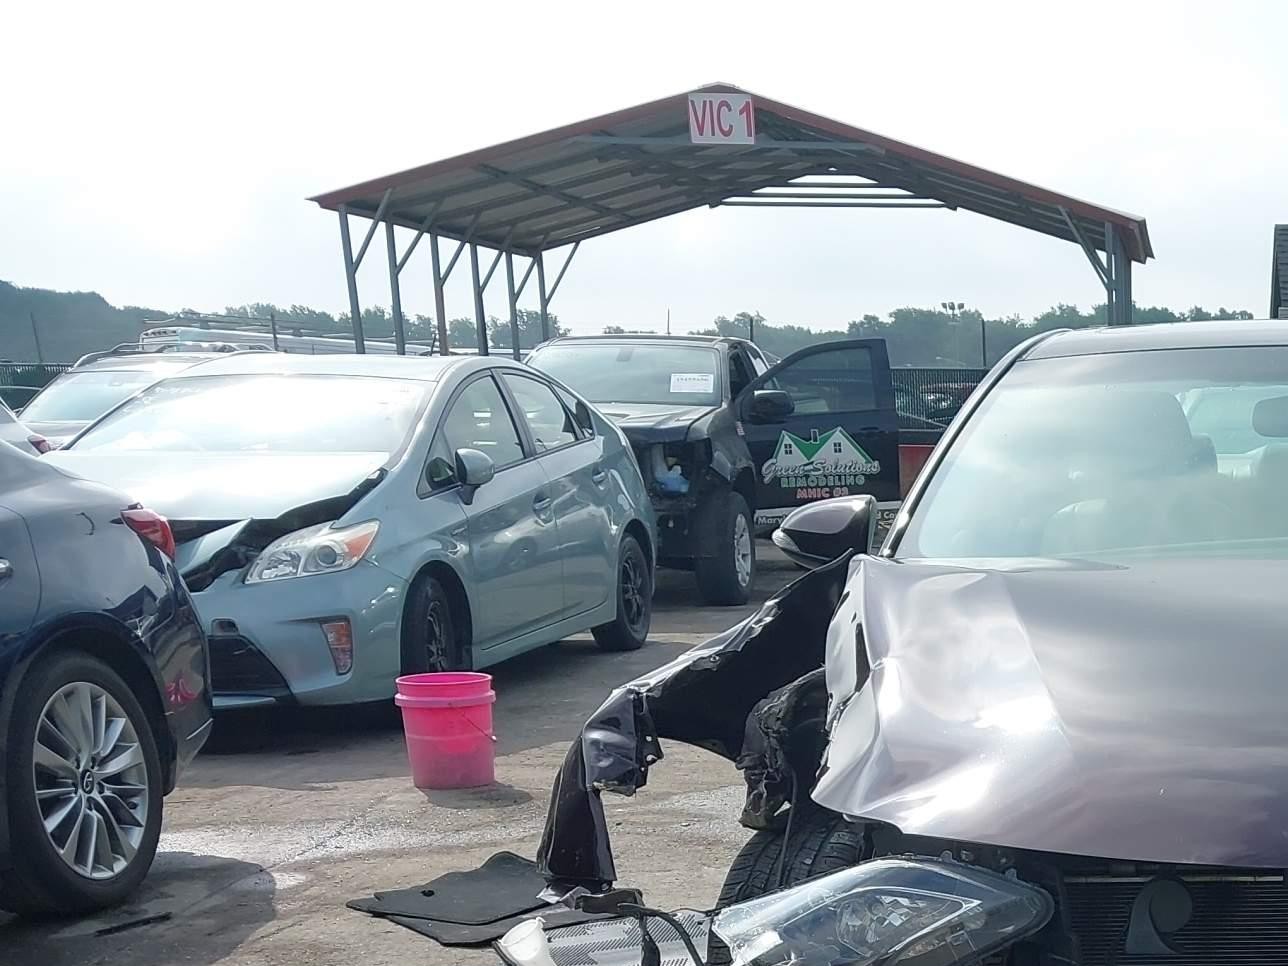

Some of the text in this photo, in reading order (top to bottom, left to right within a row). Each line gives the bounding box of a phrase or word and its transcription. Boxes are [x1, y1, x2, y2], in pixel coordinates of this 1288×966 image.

[689, 99, 753, 138] VIC 1
[761, 458, 880, 485] Green Solutions
[780, 474, 866, 488] REMODELING
